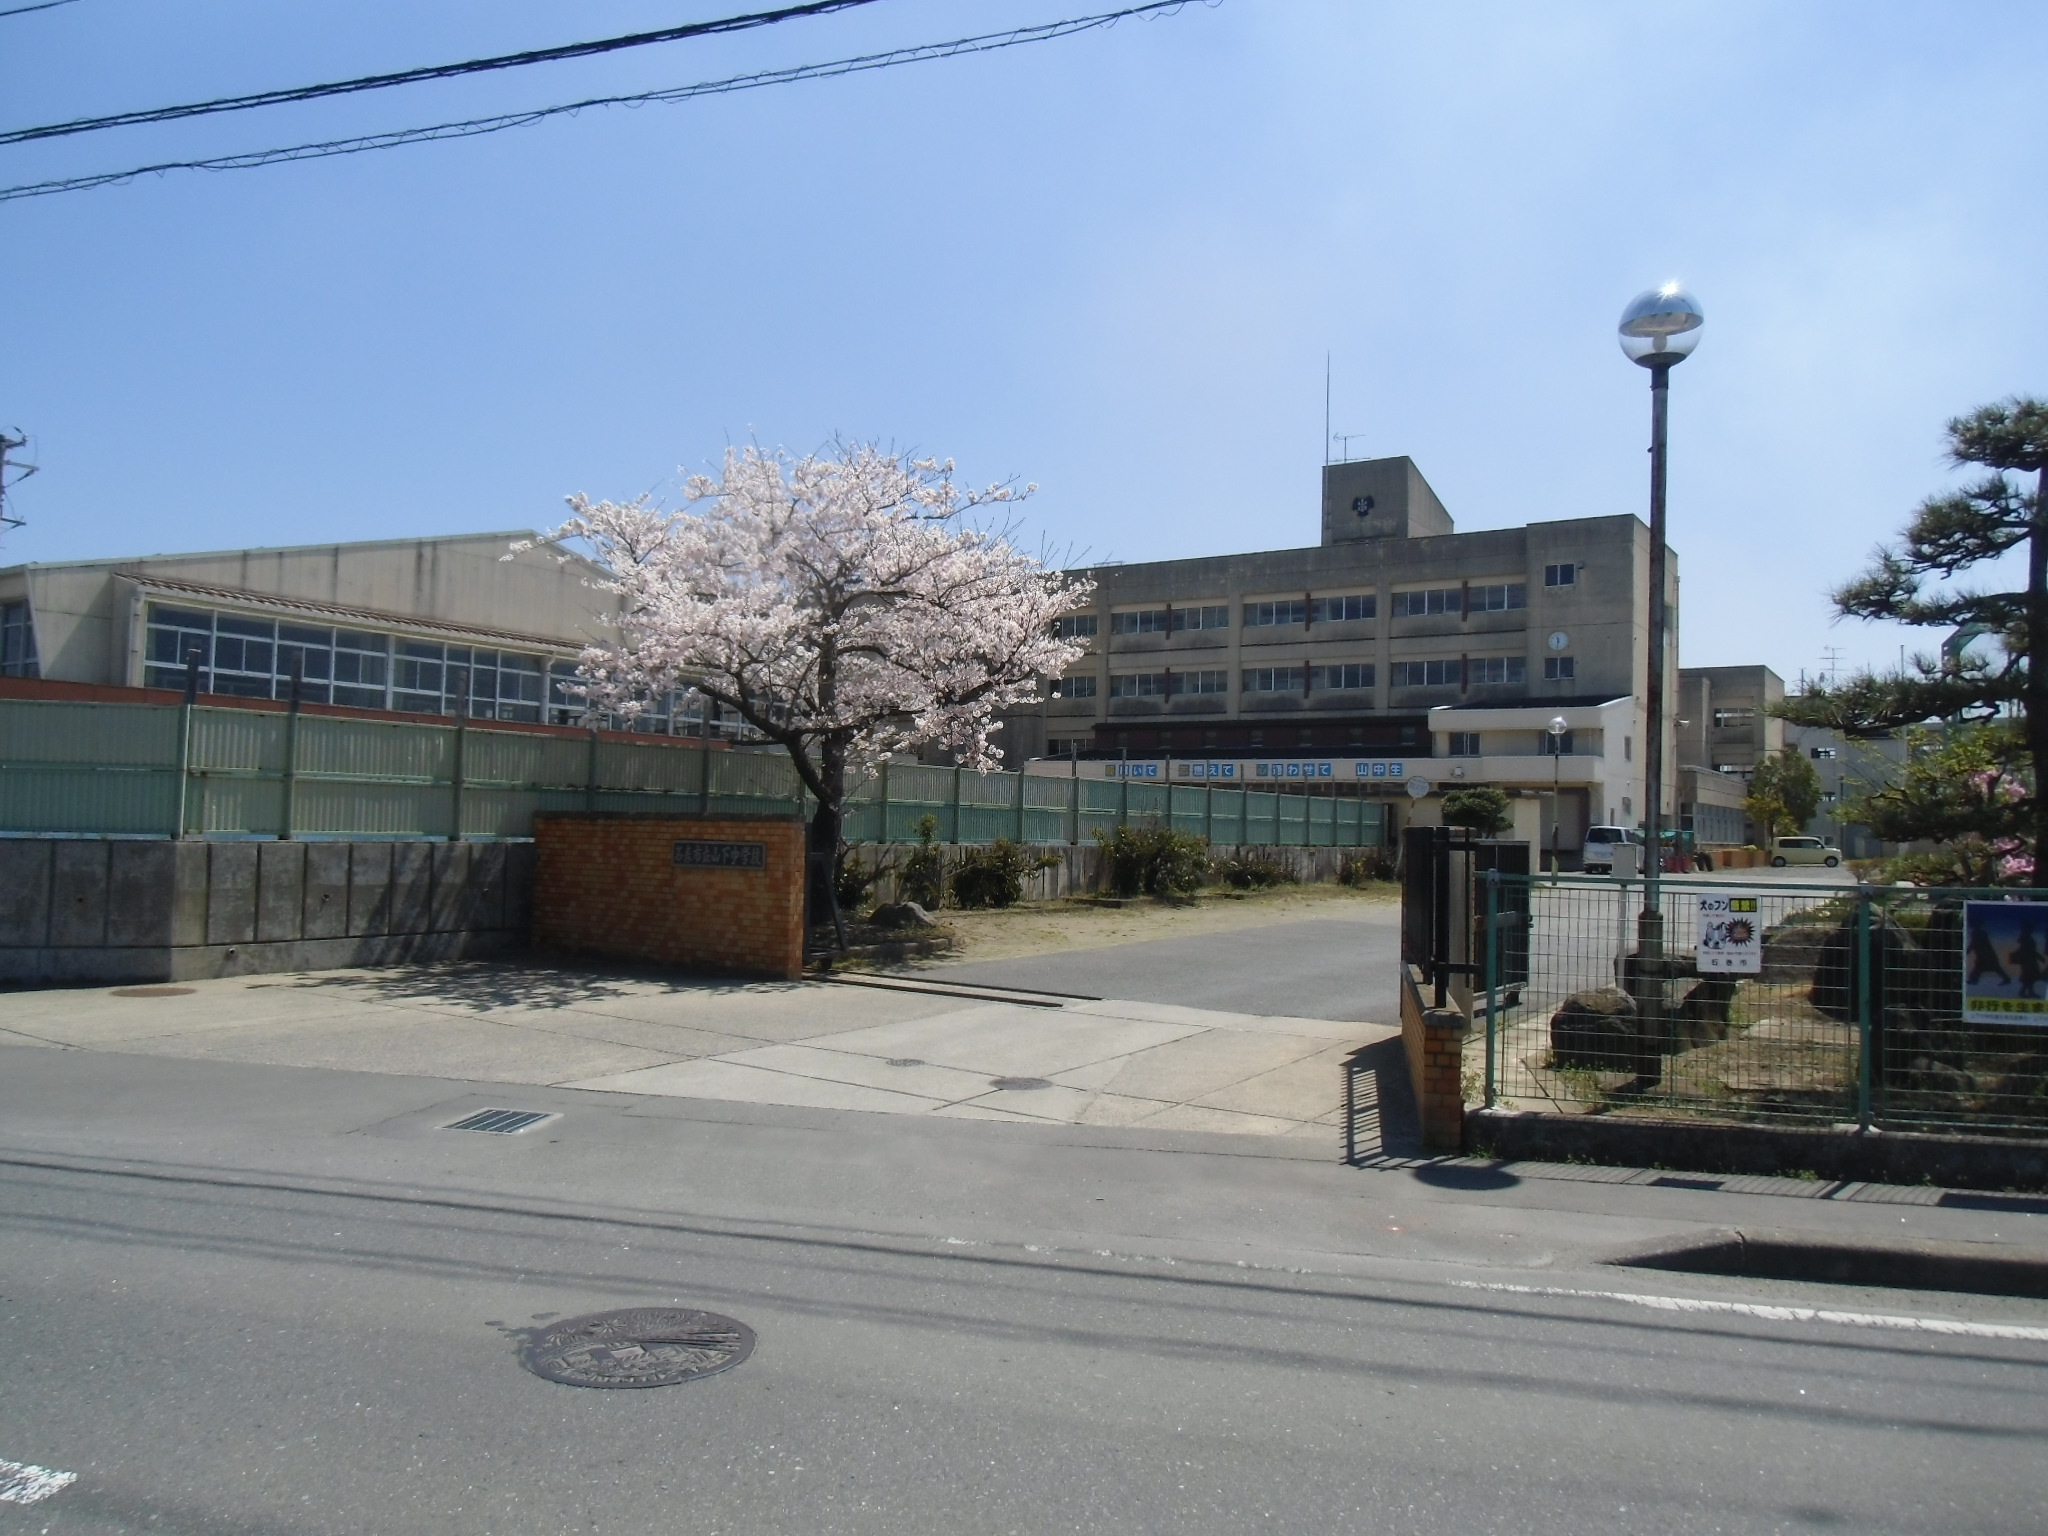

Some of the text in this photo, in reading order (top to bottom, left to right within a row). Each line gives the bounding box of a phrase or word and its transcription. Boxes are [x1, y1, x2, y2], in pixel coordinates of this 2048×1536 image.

[1105, 764, 1157, 777] いて
[1356, 762, 1403, 776] 山中生
[1970, 999, 2048, 1013] 非行を生ま
